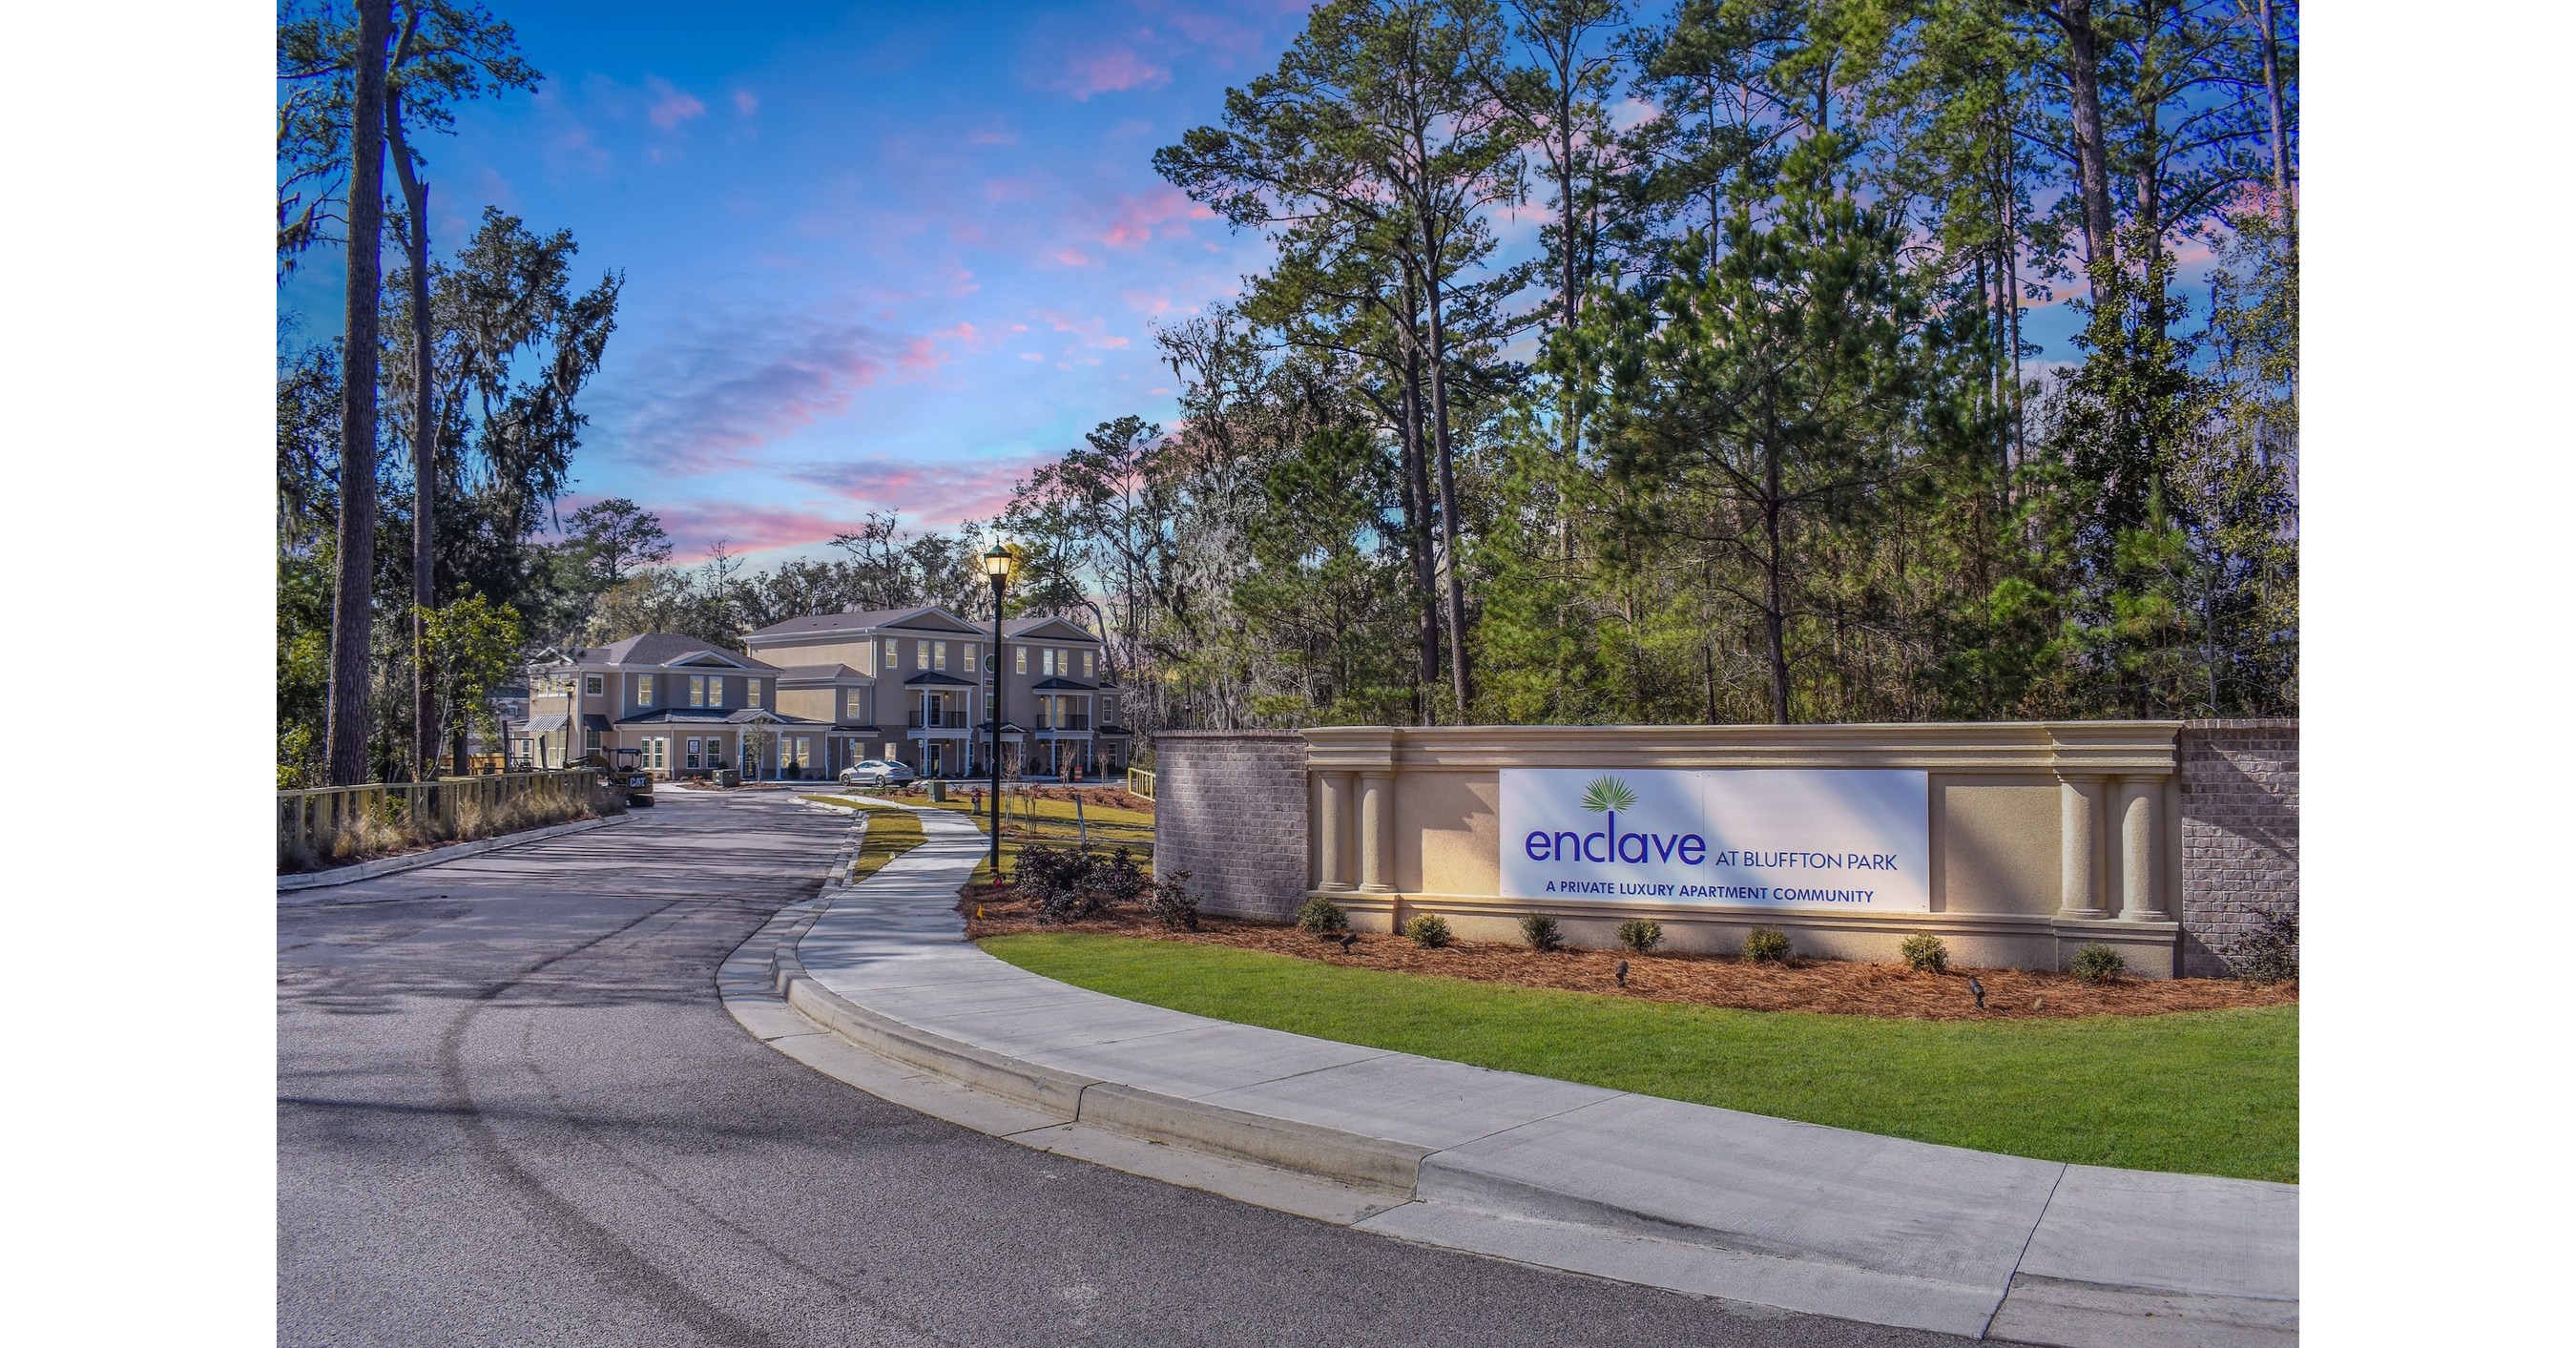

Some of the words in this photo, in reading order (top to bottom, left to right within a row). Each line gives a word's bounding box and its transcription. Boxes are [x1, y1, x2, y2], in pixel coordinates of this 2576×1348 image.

[630, 778, 646, 788] CAT
[1526, 811, 1706, 865] enclave
[1715, 851, 1739, 866] AT
[1743, 851, 1842, 868] BLUFFTON
[1848, 854, 1898, 870] PARK
[1546, 881, 1556, 892] A
[1560, 881, 1614, 894] PRIVATE
[1619, 883, 1674, 896] LUXURY
[1679, 884, 1767, 899] APARTMENT
[1773, 888, 1874, 902] COMMUNITY
